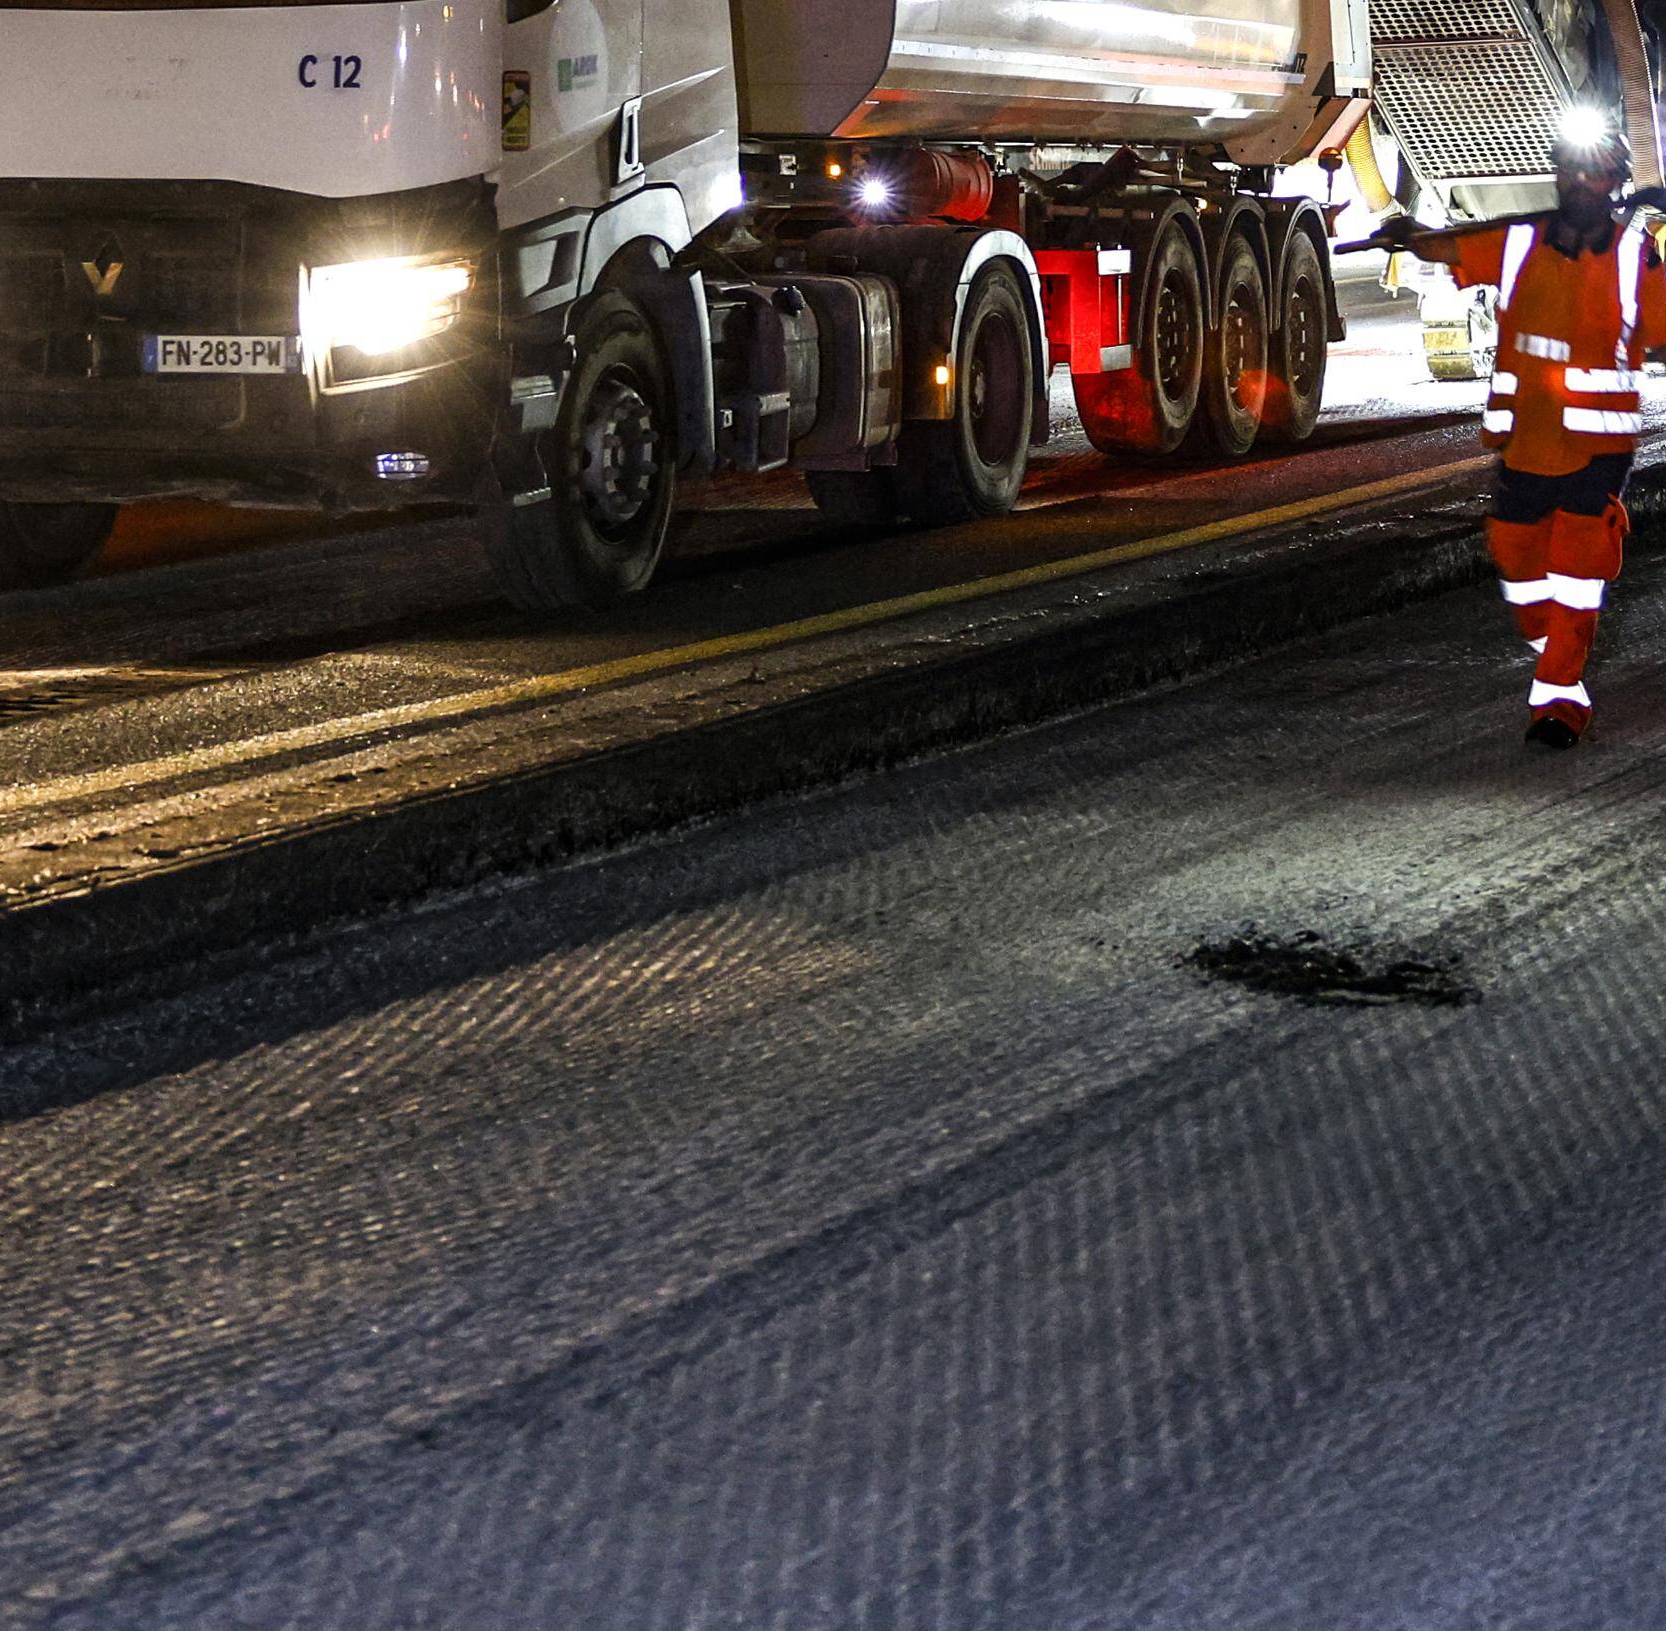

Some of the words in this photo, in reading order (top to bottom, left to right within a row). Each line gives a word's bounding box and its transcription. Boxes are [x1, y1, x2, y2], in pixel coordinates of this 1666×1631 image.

[299, 55, 317, 88] C
[333, 55, 361, 88] 12
[162, 340, 281, 367] FN-283-PW
